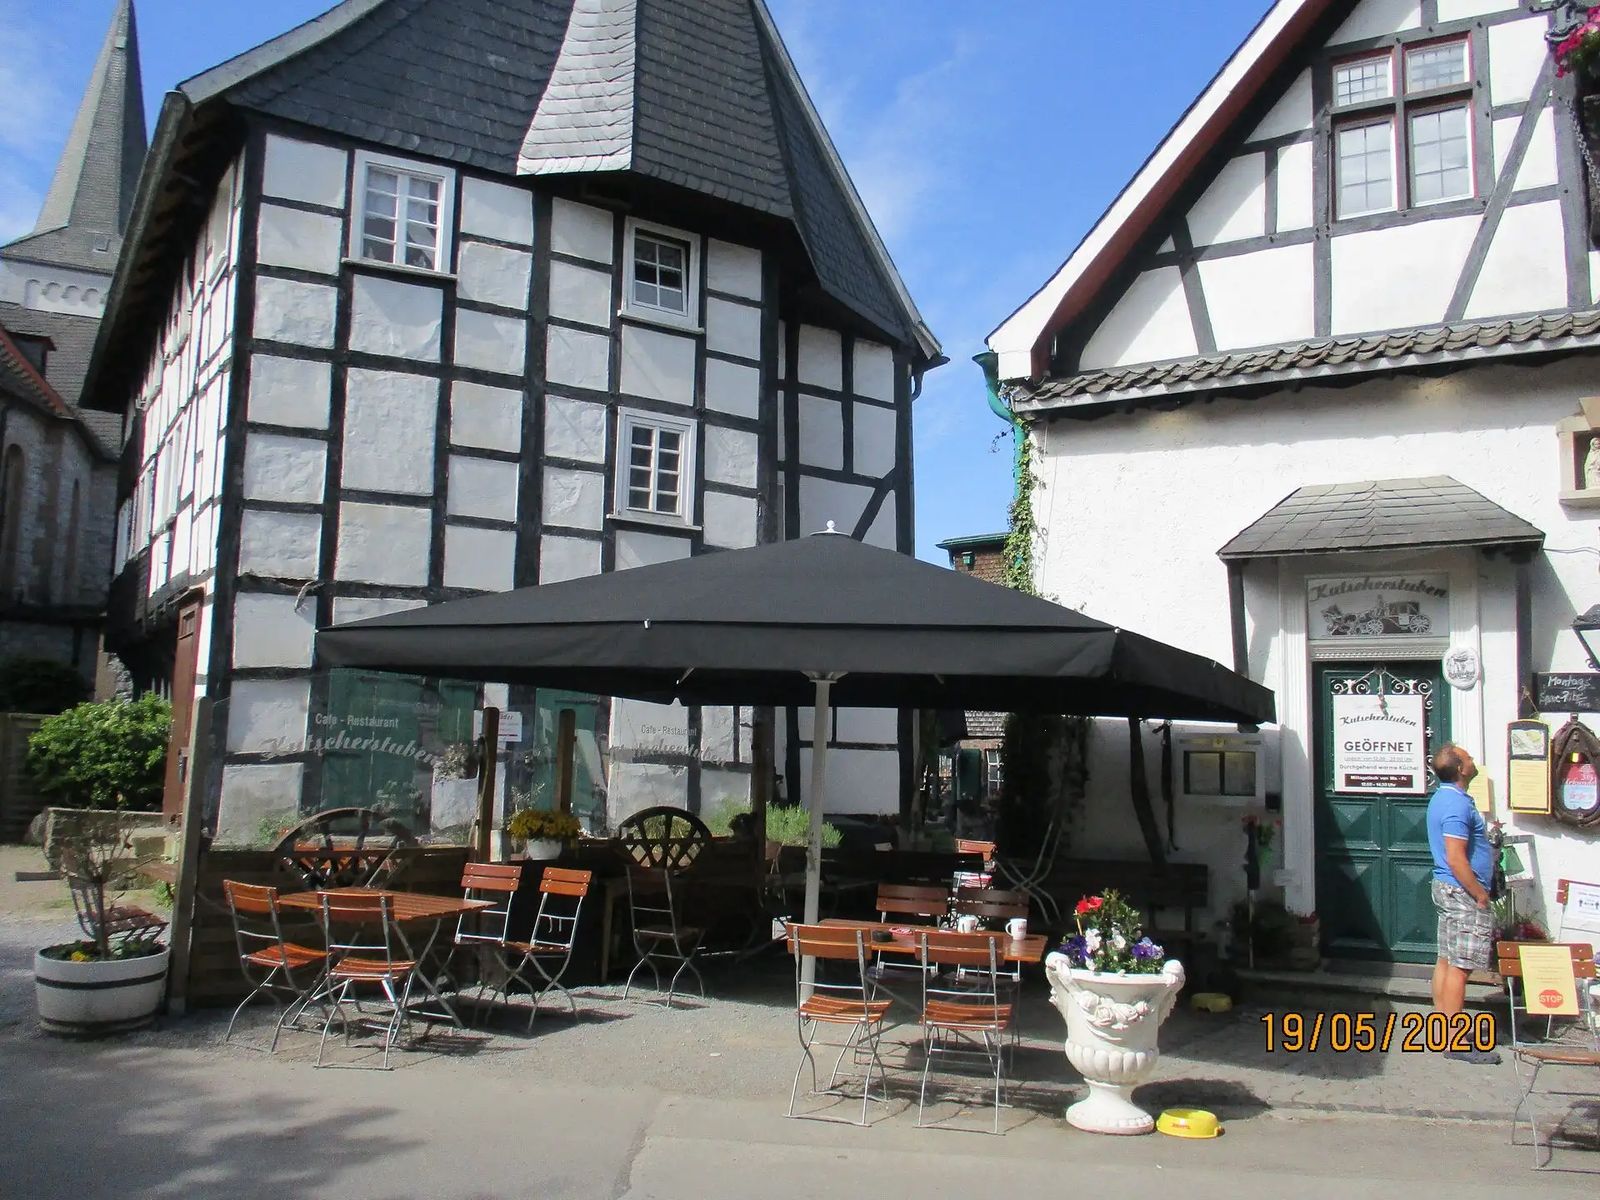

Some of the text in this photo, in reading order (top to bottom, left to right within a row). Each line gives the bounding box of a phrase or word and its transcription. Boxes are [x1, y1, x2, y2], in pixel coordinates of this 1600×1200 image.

[1310, 575, 1448, 599] Kutscherstuben
[346, 714, 400, 728] Restaurant
[1340, 713, 1417, 727] Kutscherstuben
[641, 724, 657, 735] Cafe
[662, 725, 698, 737] Restaurant
[1344, 738, 1413, 752] GEÖFFNET
[1540, 994, 1564, 1003] STOP
